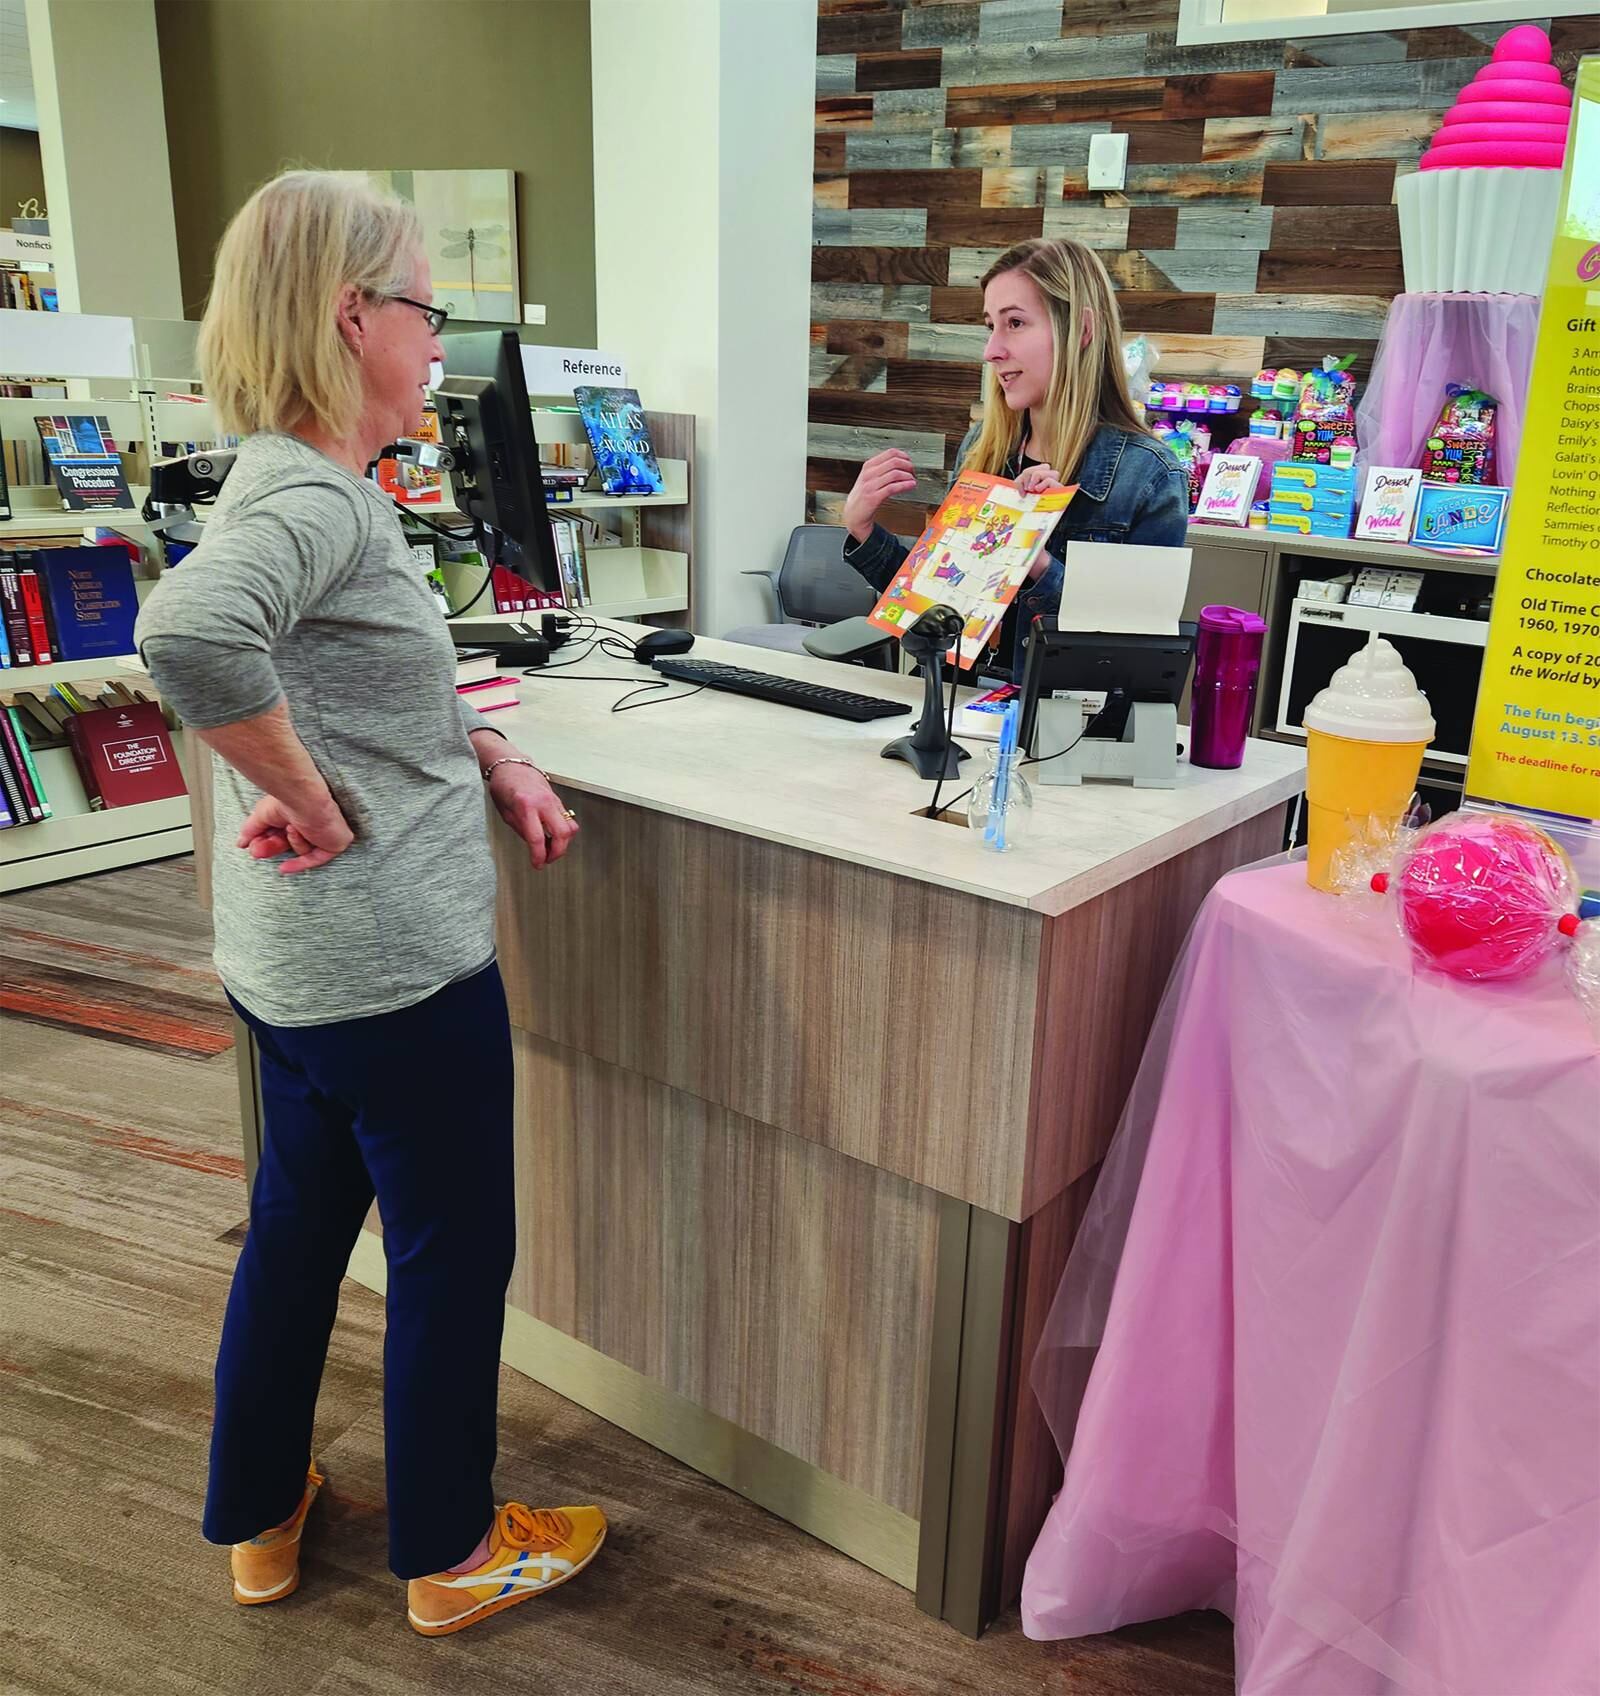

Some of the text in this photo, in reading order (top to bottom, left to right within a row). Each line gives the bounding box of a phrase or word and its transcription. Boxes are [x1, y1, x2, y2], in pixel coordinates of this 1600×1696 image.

[1567, 319, 1597, 332] Gift
[1572, 348, 1580, 359] 3
[563, 359, 622, 376] Reference
[600, 411, 643, 430] ATLAS
[1560, 417, 1600, 432] Daisy's
[603, 439, 650, 454] WORLD
[1558, 434, 1598, 448] Emily's
[1555, 451, 1597, 464] Galati's
[60, 466, 119, 480] Congressional
[1215, 461, 1251, 476] Dessert
[1552, 468, 1587, 480] Lovin'
[72, 477, 116, 488] Procedure
[1374, 475, 1414, 492] Dessert
[1204, 493, 1241, 510] World
[1549, 486, 1597, 501] Nothing
[1365, 511, 1405, 529] World
[1424, 503, 1500, 535] CANDY
[1544, 519, 1594, 533] Sammies
[1541, 535, 1588, 551] Timothy
[1526, 568, 1600, 587] Chocolate
[1521, 598, 1547, 611] Old
[1551, 600, 1587, 615] Time
[1520, 617, 1558, 634] 1960,
[1512, 646, 1522, 658] A
[1527, 650, 1562, 664] copy
[1566, 653, 1582, 664] of
[1510, 664, 1600, 689] the World by
[1504, 704, 1531, 718] The
[1535, 708, 1561, 722] fun
[1500, 722, 1556, 740] August
[1562, 731, 1583, 744] 13.
[113, 747, 157, 760] FOUNDATION
[118, 754, 156, 766] DIRECTORY
[1496, 751, 1516, 763] The
[1519, 756, 1569, 772] deadline
[1571, 764, 1588, 774] for
